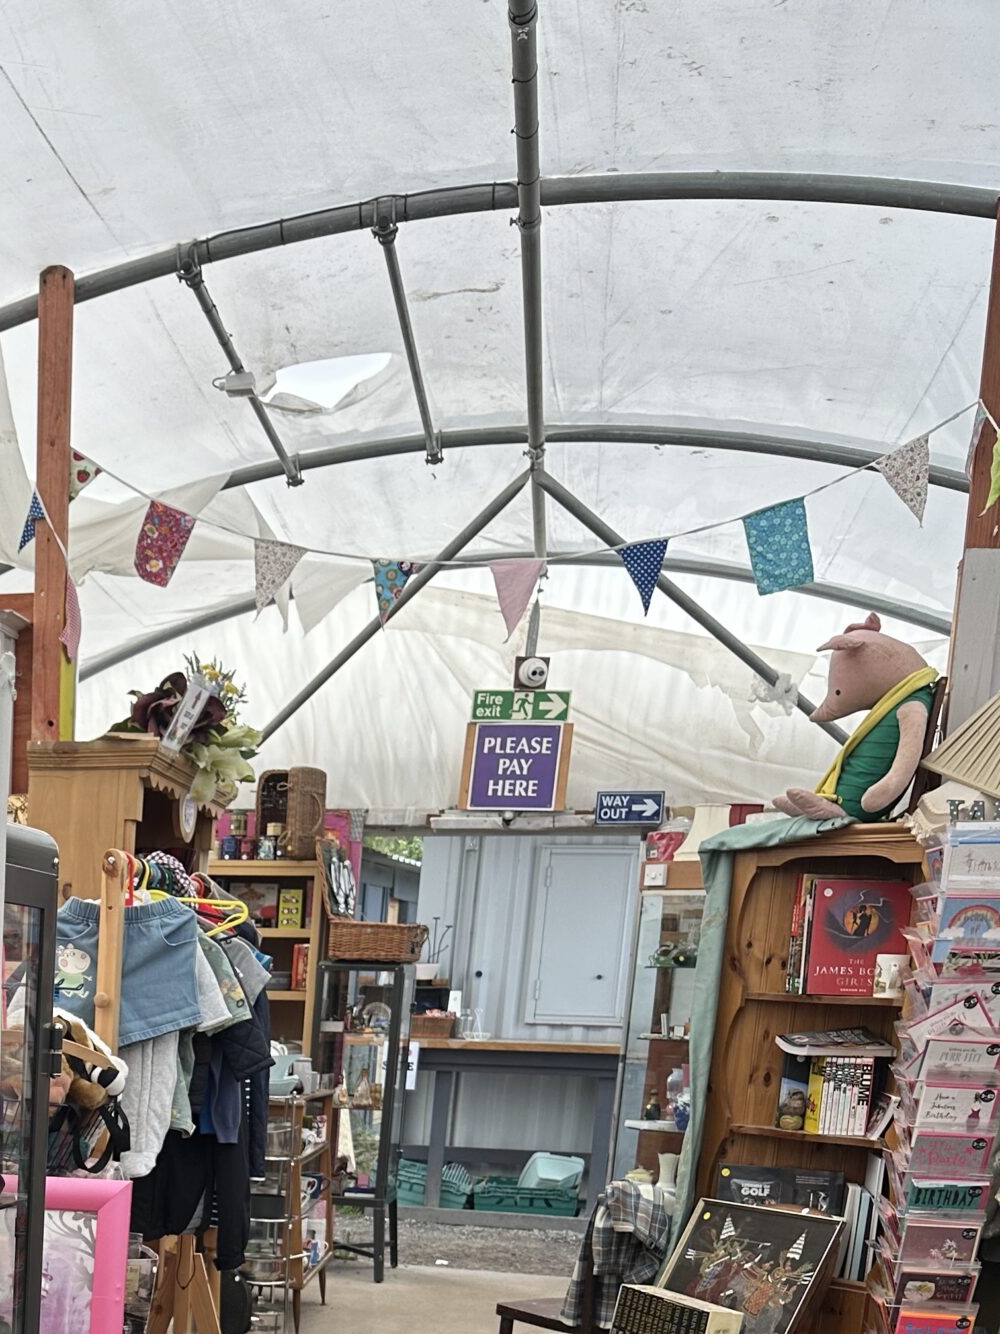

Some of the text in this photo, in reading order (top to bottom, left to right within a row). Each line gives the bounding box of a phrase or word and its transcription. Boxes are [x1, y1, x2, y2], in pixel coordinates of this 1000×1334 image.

[477, 693, 503, 705] Fire
[476, 705, 501, 717] exit
[483, 737, 553, 754] PLEASE
[498, 759, 533, 775] PAY
[487, 780, 539, 797] HERE
[601, 795, 630, 806] WAY
[600, 808, 629, 819] OUT
[814, 965, 853, 976] JAMES
[857, 1064, 872, 1106] BLUME
[923, 1110, 957, 1121] Birthday
[741, 1187, 771, 1197] GOLF
[915, 1187, 975, 1207] BIRTHDAY
